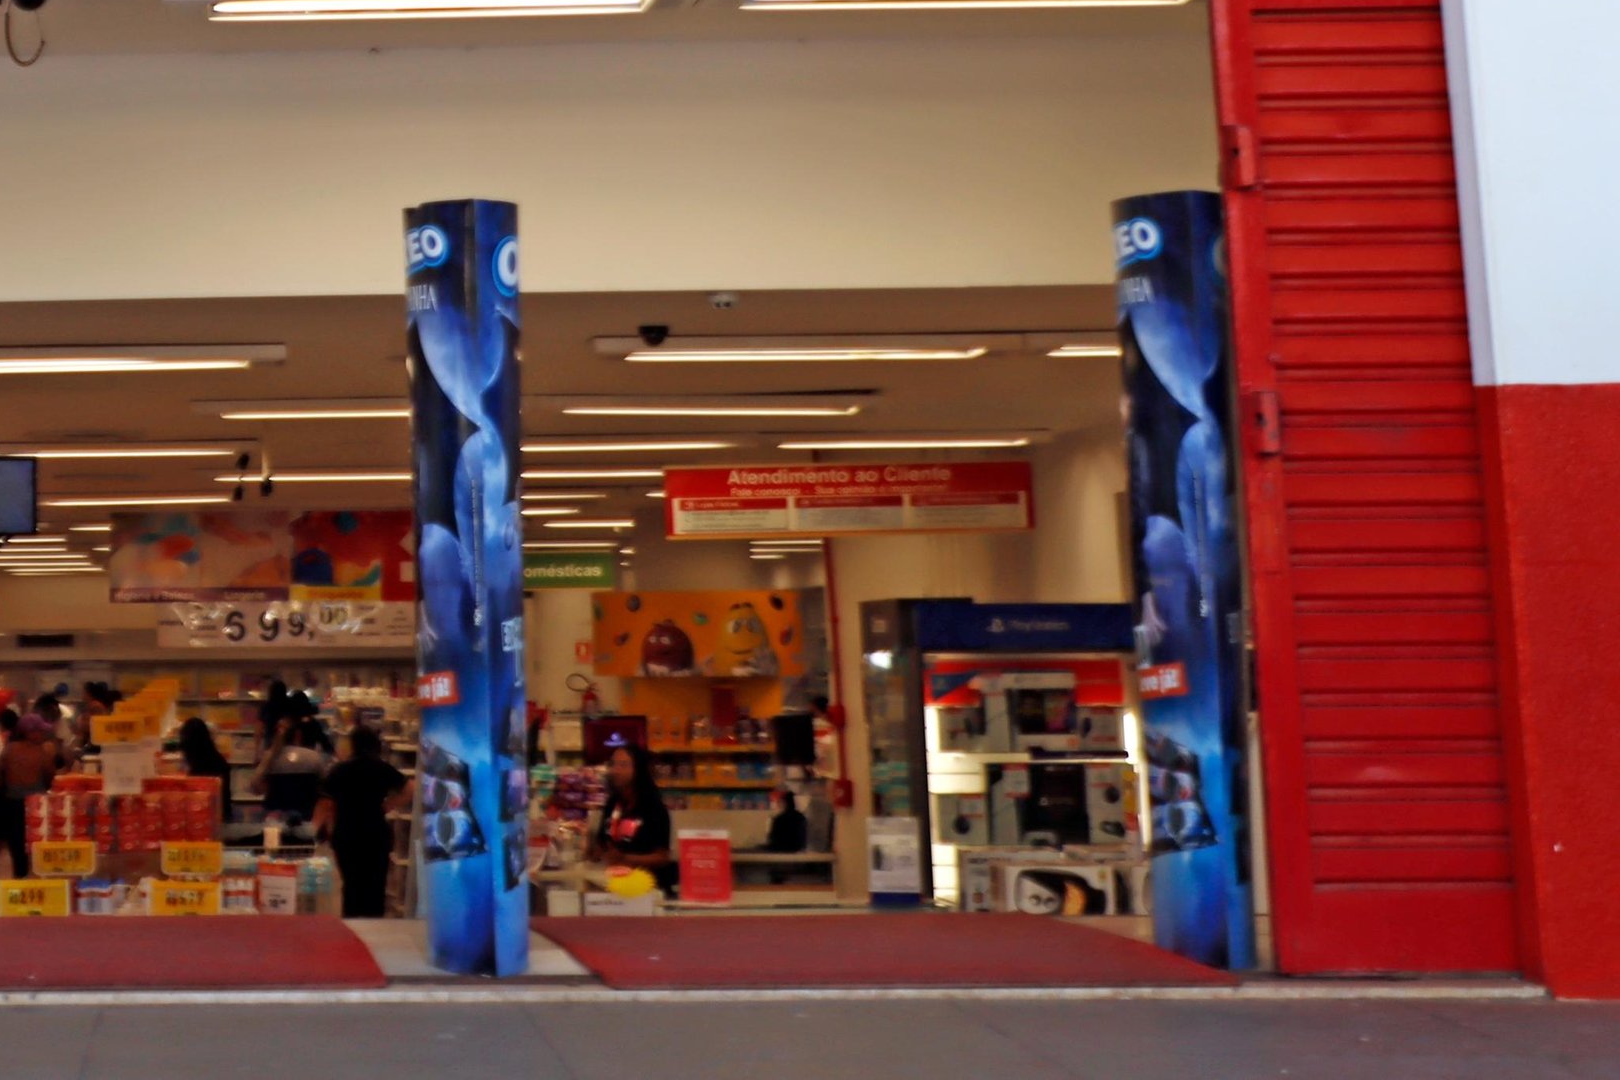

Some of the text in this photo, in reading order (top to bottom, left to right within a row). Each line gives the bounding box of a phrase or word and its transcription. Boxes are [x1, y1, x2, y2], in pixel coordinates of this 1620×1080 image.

[727, 466, 952, 485] Atendimento ao Cliente
